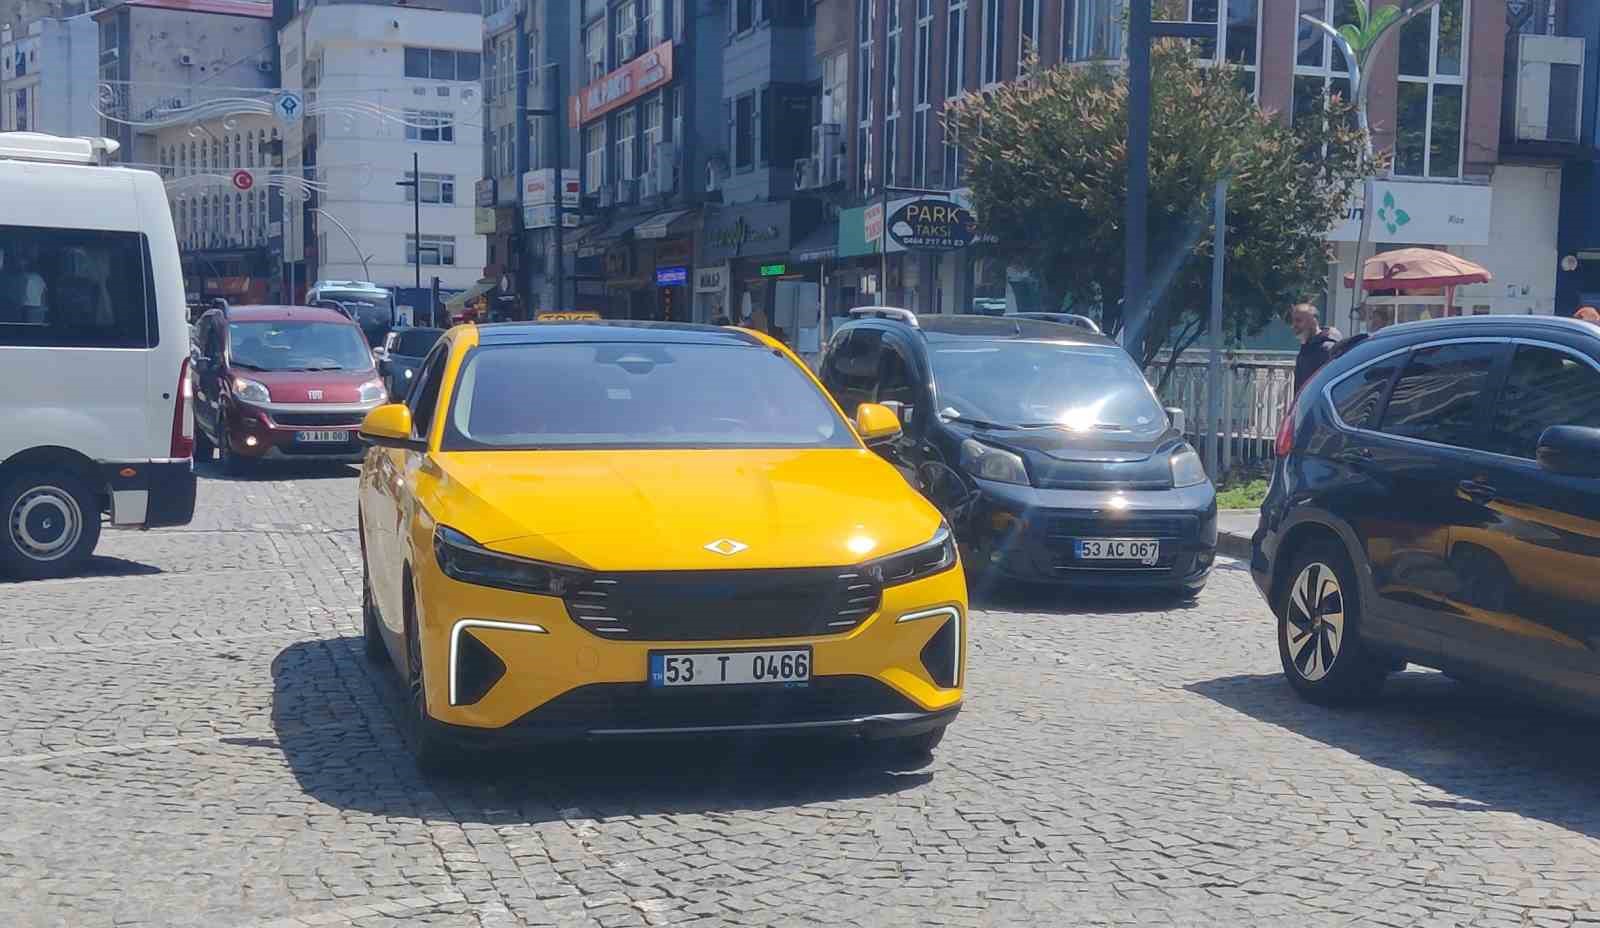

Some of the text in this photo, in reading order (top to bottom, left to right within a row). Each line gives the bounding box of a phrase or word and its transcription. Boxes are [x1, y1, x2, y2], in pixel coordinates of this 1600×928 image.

[906, 205, 960, 224] PARK
[1082, 542, 1101, 557] 53
[1106, 542, 1125, 557] AC
[1129, 542, 1158, 558] 067
[666, 657, 695, 683] 53
[717, 656, 730, 682] T
[752, 653, 808, 680] 0466
